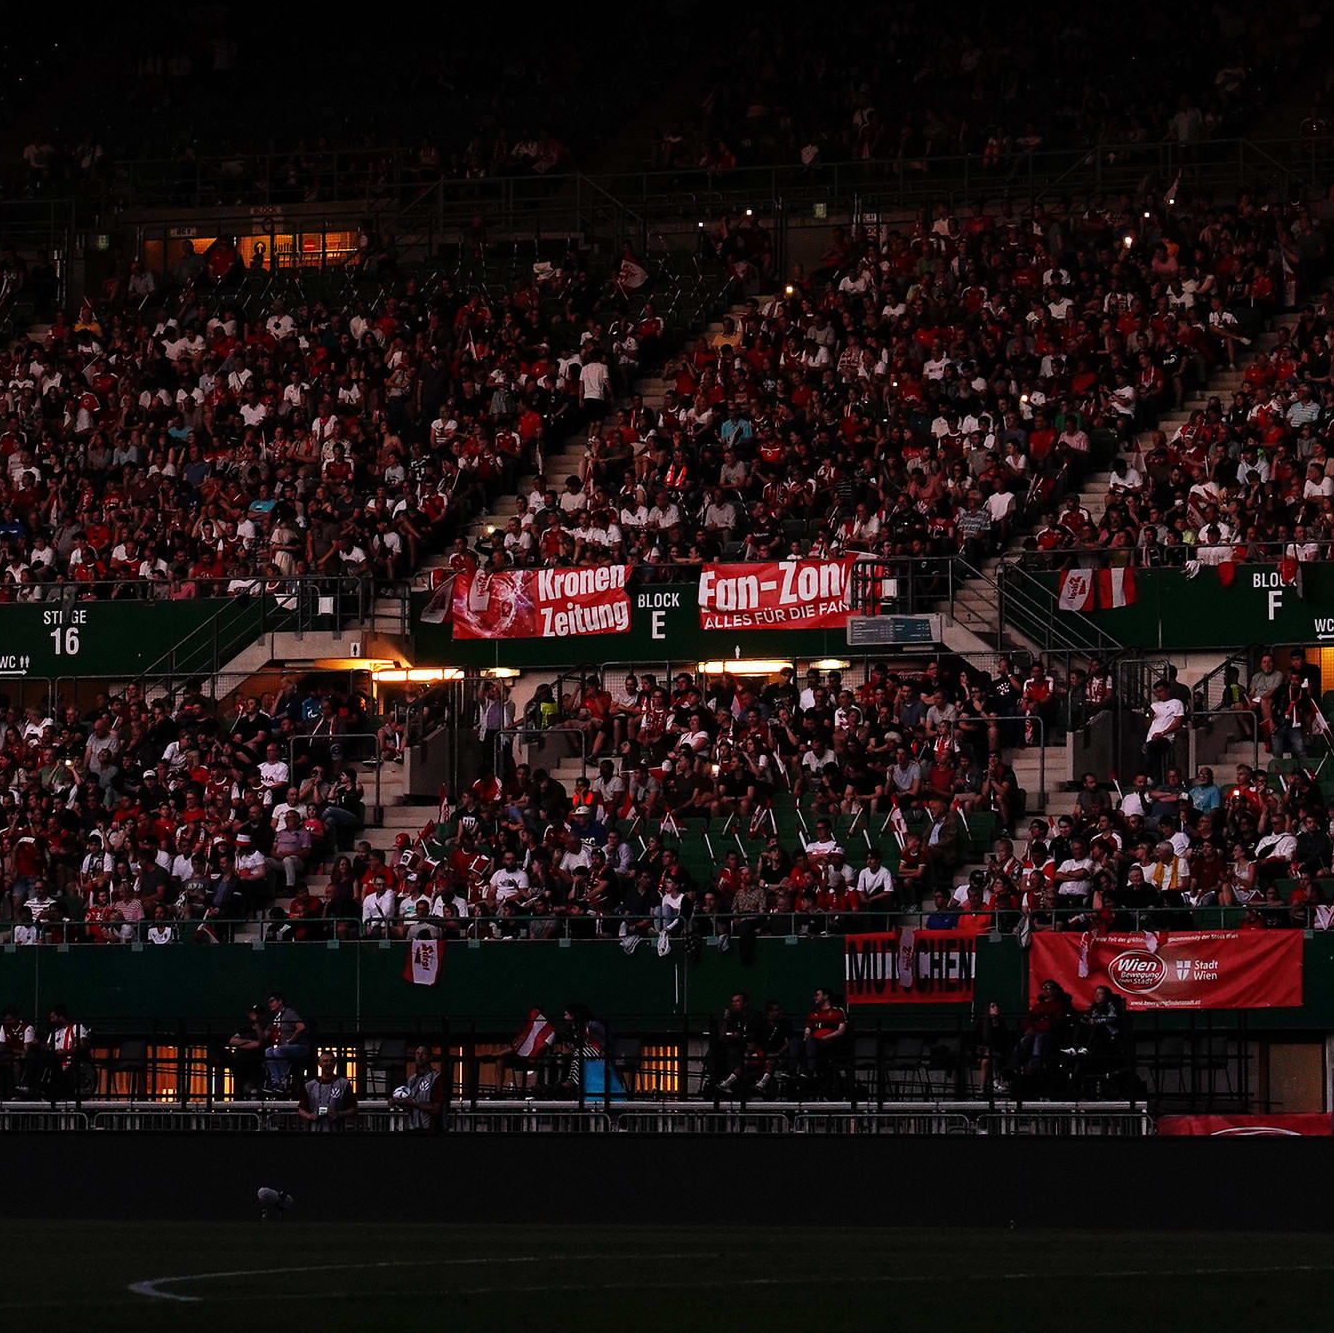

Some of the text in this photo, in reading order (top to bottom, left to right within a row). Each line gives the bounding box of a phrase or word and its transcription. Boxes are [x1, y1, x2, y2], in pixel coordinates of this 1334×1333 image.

[537, 564, 626, 602] Kronen
[1252, 572, 1298, 588] BLO
[637, 592, 680, 609] BLOCK
[1267, 590, 1283, 621] F
[43, 609, 87, 625] STIGE
[540, 600, 629, 638] Zeitung
[704, 601, 850, 630] ALLES FÜR DIE FAN
[651, 610, 667, 640] E
[1314, 618, 1334, 632] WC
[50, 626, 80, 656] 16
[847, 938, 973, 994] MUTCHEN
[1117, 958, 1158, 972] Wien
[1194, 959, 1219, 970] Stadt
[1133, 977, 1154, 985] Stadt
[1194, 971, 1218, 981] Wien
